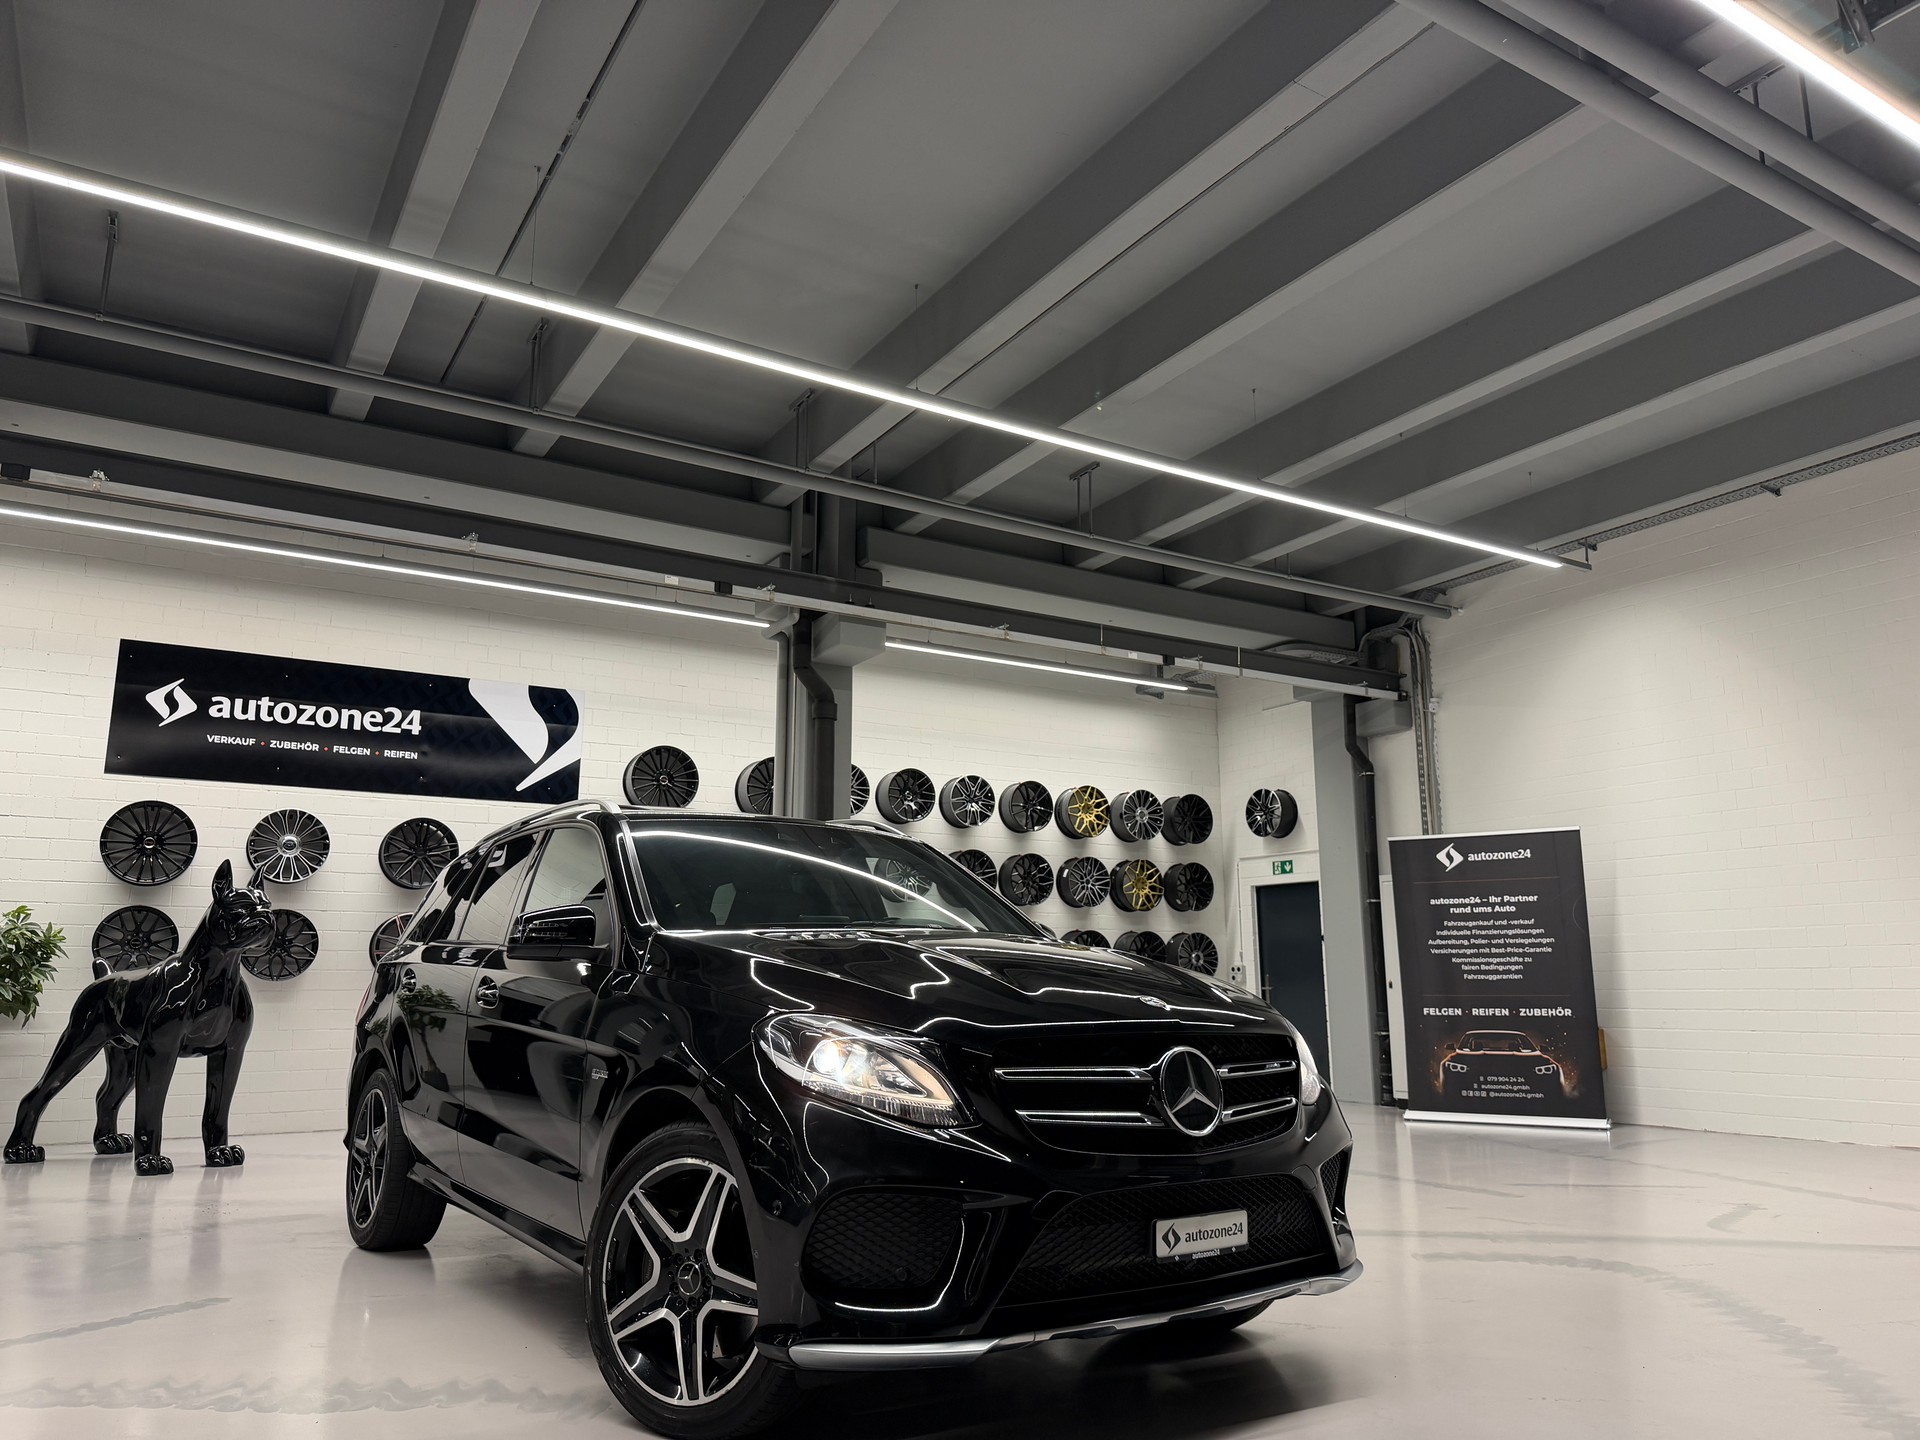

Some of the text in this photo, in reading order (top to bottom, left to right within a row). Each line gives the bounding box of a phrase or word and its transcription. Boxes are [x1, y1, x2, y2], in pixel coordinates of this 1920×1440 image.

[208, 694, 422, 736] autozone24
[206, 733, 418, 760] VERKAUF ZUBEHÖR FELGEN REIFEN
[1467, 848, 1531, 862] autozone24
[1430, 896, 1481, 905] autozone24
[1489, 895, 1501, 903] Ihr
[1503, 894, 1538, 903] Partner
[1450, 905, 1471, 914] rund
[1494, 904, 1516, 912] Auto
[1443, 919, 1494, 928] Fahrzeugankauf
[1471, 927, 1545, 937] Finanzierungslösungen
[1428, 938, 1470, 946] Aufbereitung,
[1505, 935, 1555, 945] Versiegelungen
[1430, 947, 1479, 955] Versicherungen
[1490, 945, 1552, 954] Best-Price-Garantie
[1452, 956, 1523, 965] Kommissionsgeschäfte
[1480, 964, 1524, 972] Bedingungen
[1463, 973, 1523, 981] Fahrzeuggarantien
[1423, 1006, 1572, 1017] FELGEN REIFEN ZUBEHÖR
[1184, 1222, 1243, 1243] autozone24
[1191, 1248, 1220, 1260] autozone24
